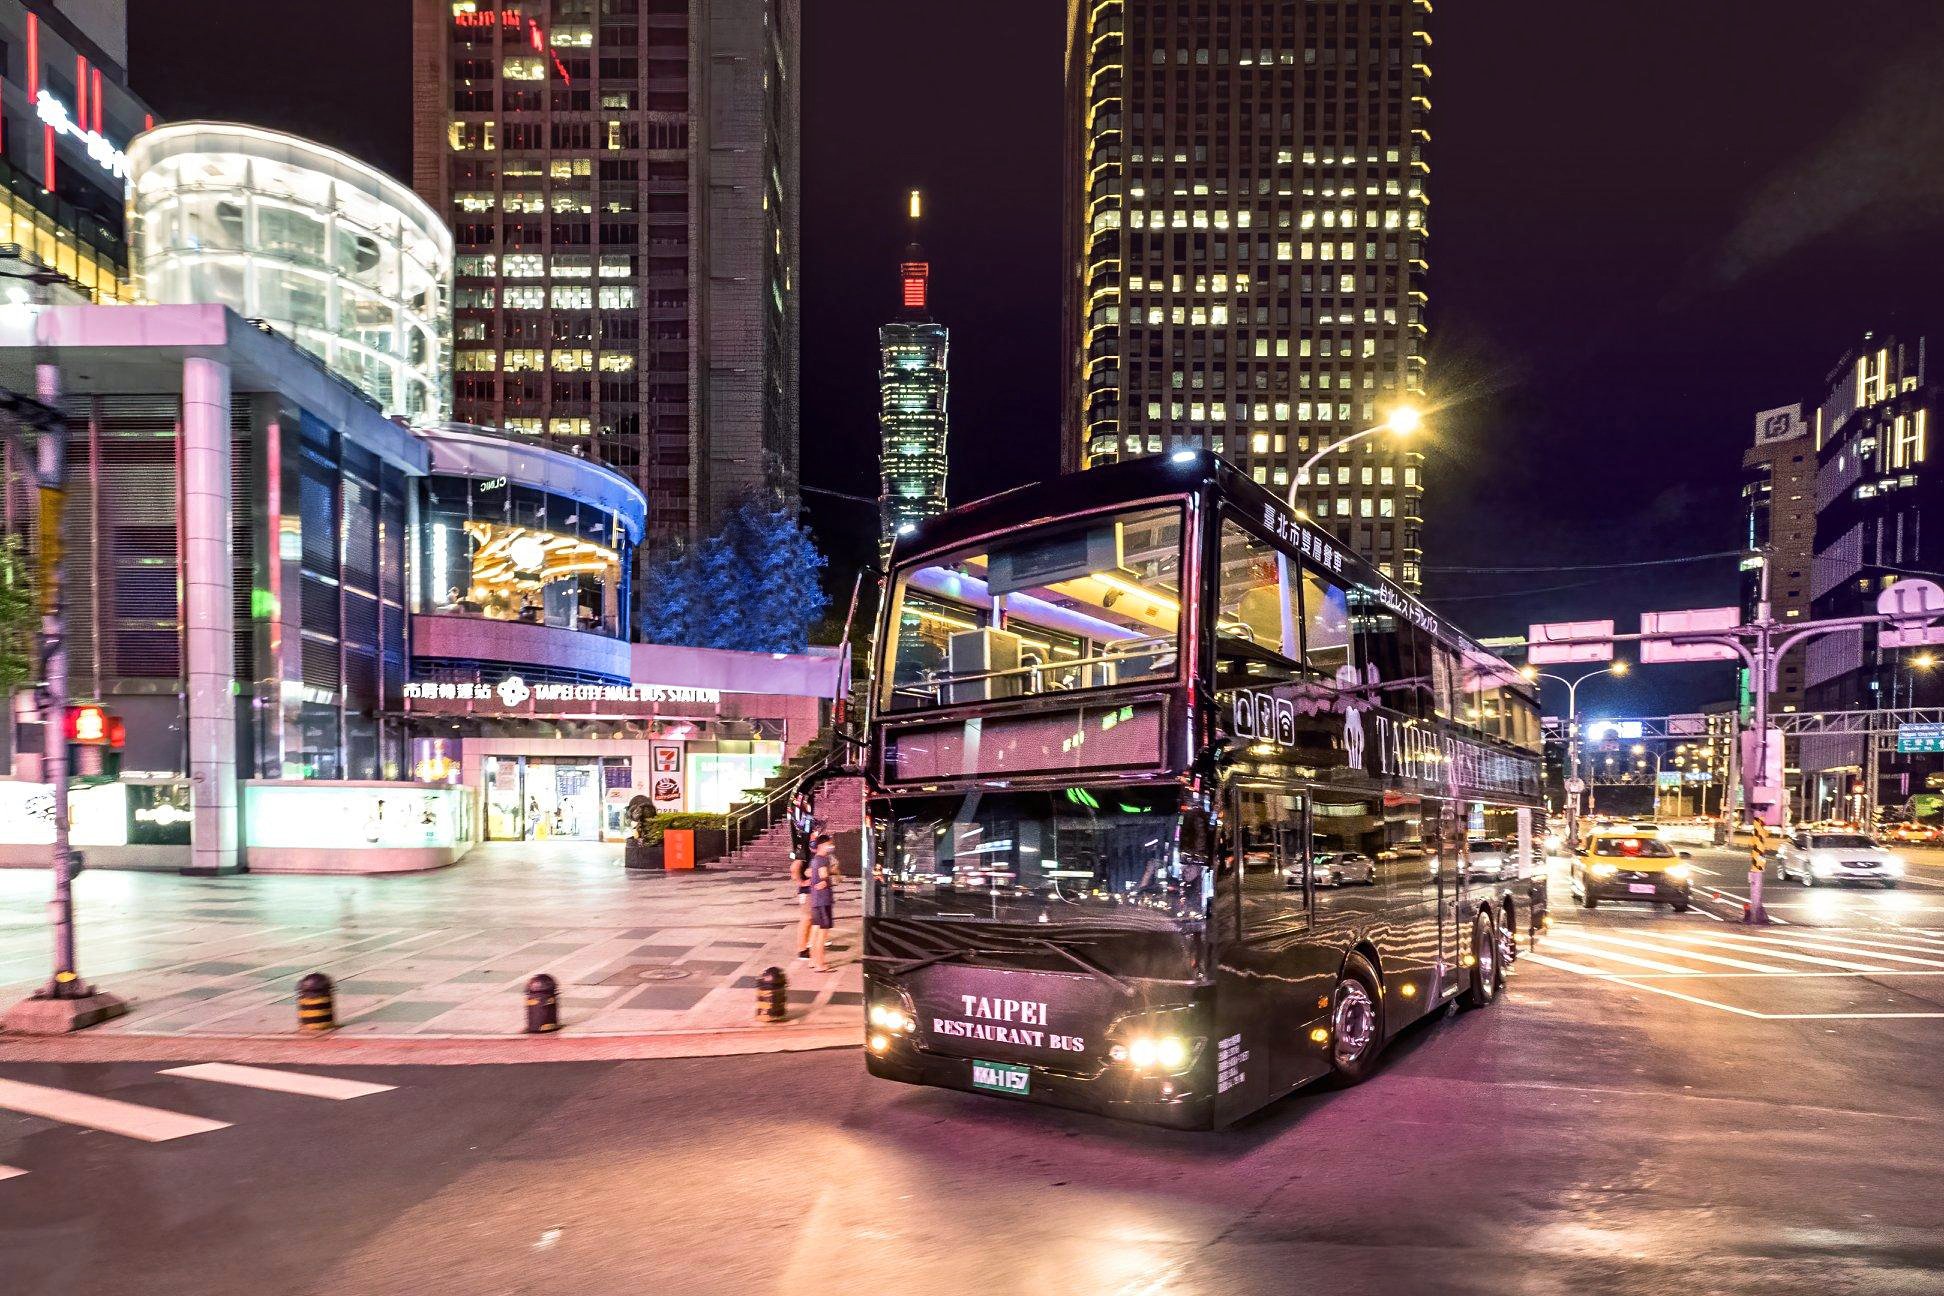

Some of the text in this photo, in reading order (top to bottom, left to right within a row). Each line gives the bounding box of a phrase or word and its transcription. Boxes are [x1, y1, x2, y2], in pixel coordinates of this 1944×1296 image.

[535, 685, 720, 703] TAIPEI CITY HALL BUS STATION
[961, 994, 1048, 1026] TAIPEI
[933, 1018, 1085, 1052] RESTAURANT BUS
